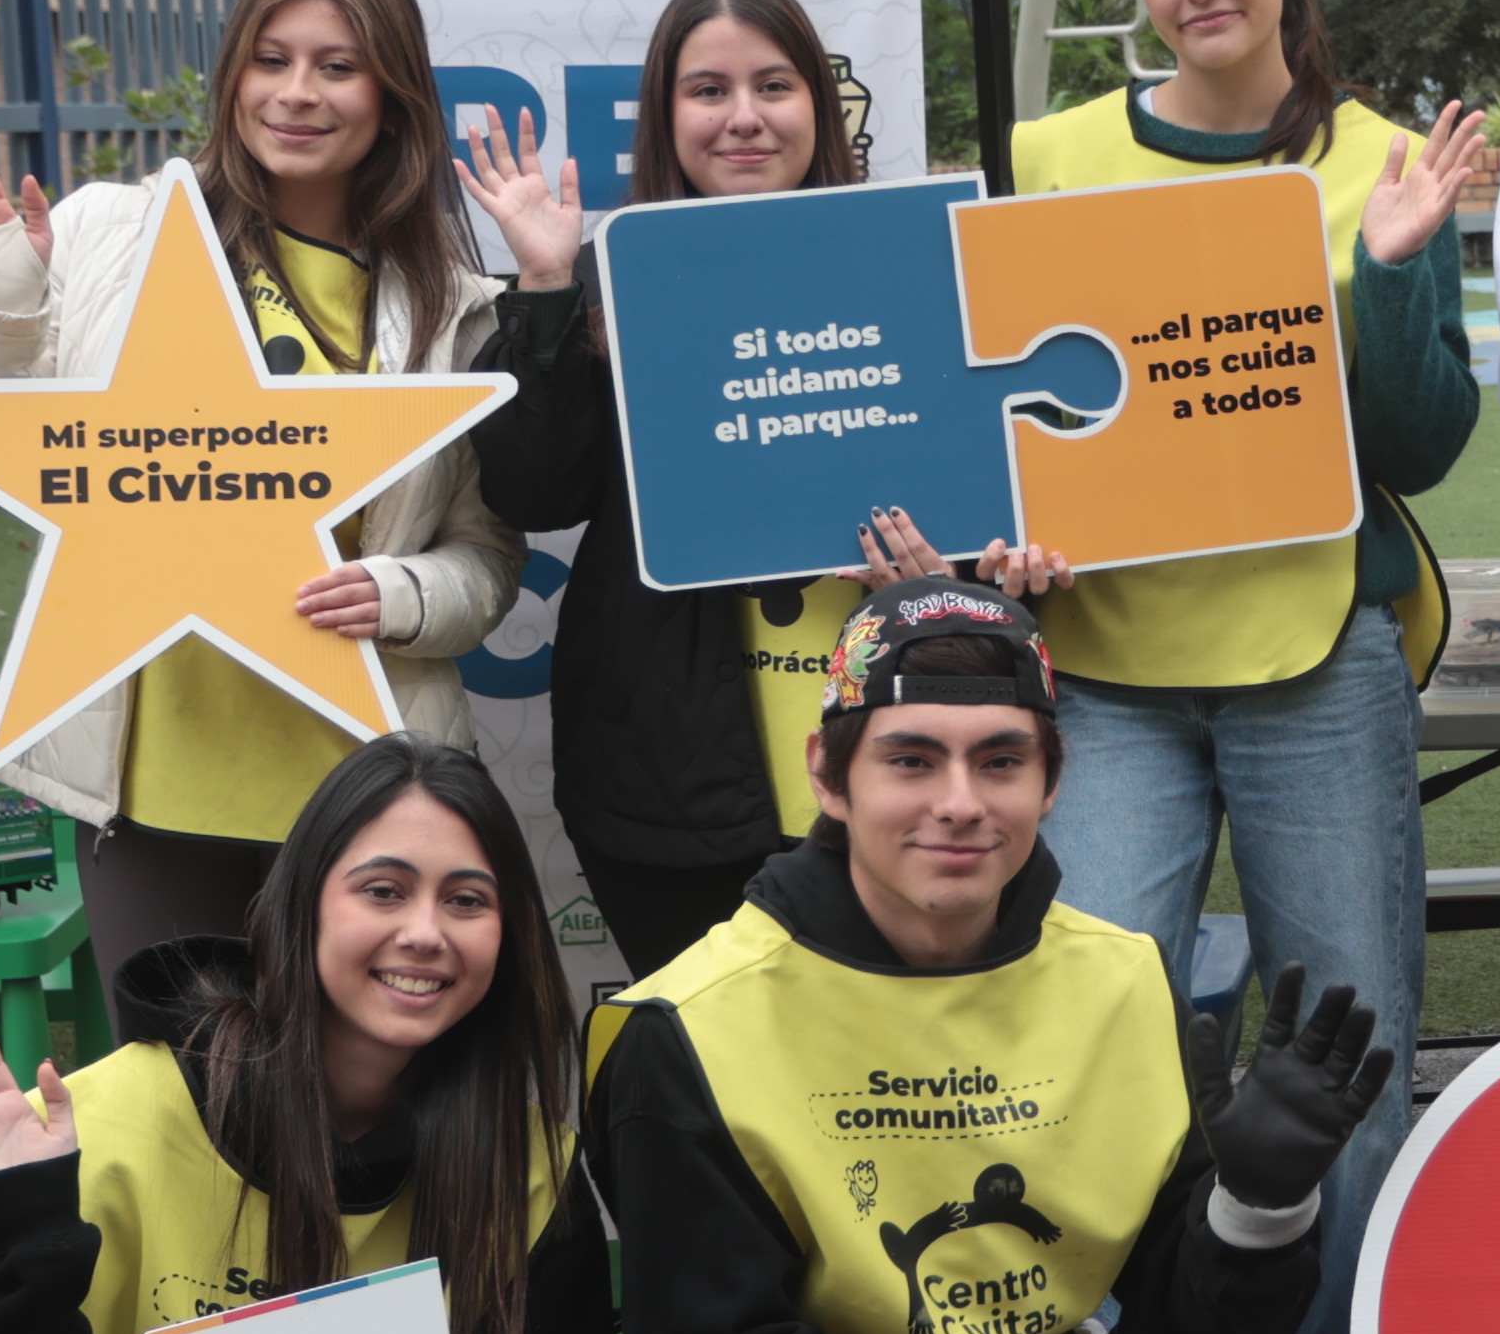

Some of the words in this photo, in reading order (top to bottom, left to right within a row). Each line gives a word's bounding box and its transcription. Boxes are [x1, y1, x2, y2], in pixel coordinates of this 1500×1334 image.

[732, 327, 768, 360] Si
[776, 322, 882, 355] todos
[1201, 304, 1325, 343] parque
[1147, 356, 1212, 383] nos
[1220, 341, 1317, 374] cuida
[722, 363, 902, 402] cuidamos
[1172, 398, 1193, 420] a
[1201, 384, 1302, 416] todos
[42, 420, 87, 450] Mi
[97, 419, 329, 454] superpoder:
[714, 413, 749, 443] el
[40, 466, 89, 505] El
[108, 460, 333, 504] Civismo
[868, 1065, 998, 1098] Servicio
[835, 1095, 1040, 1130] comunitario
[924, 1264, 1048, 1311] Centro
